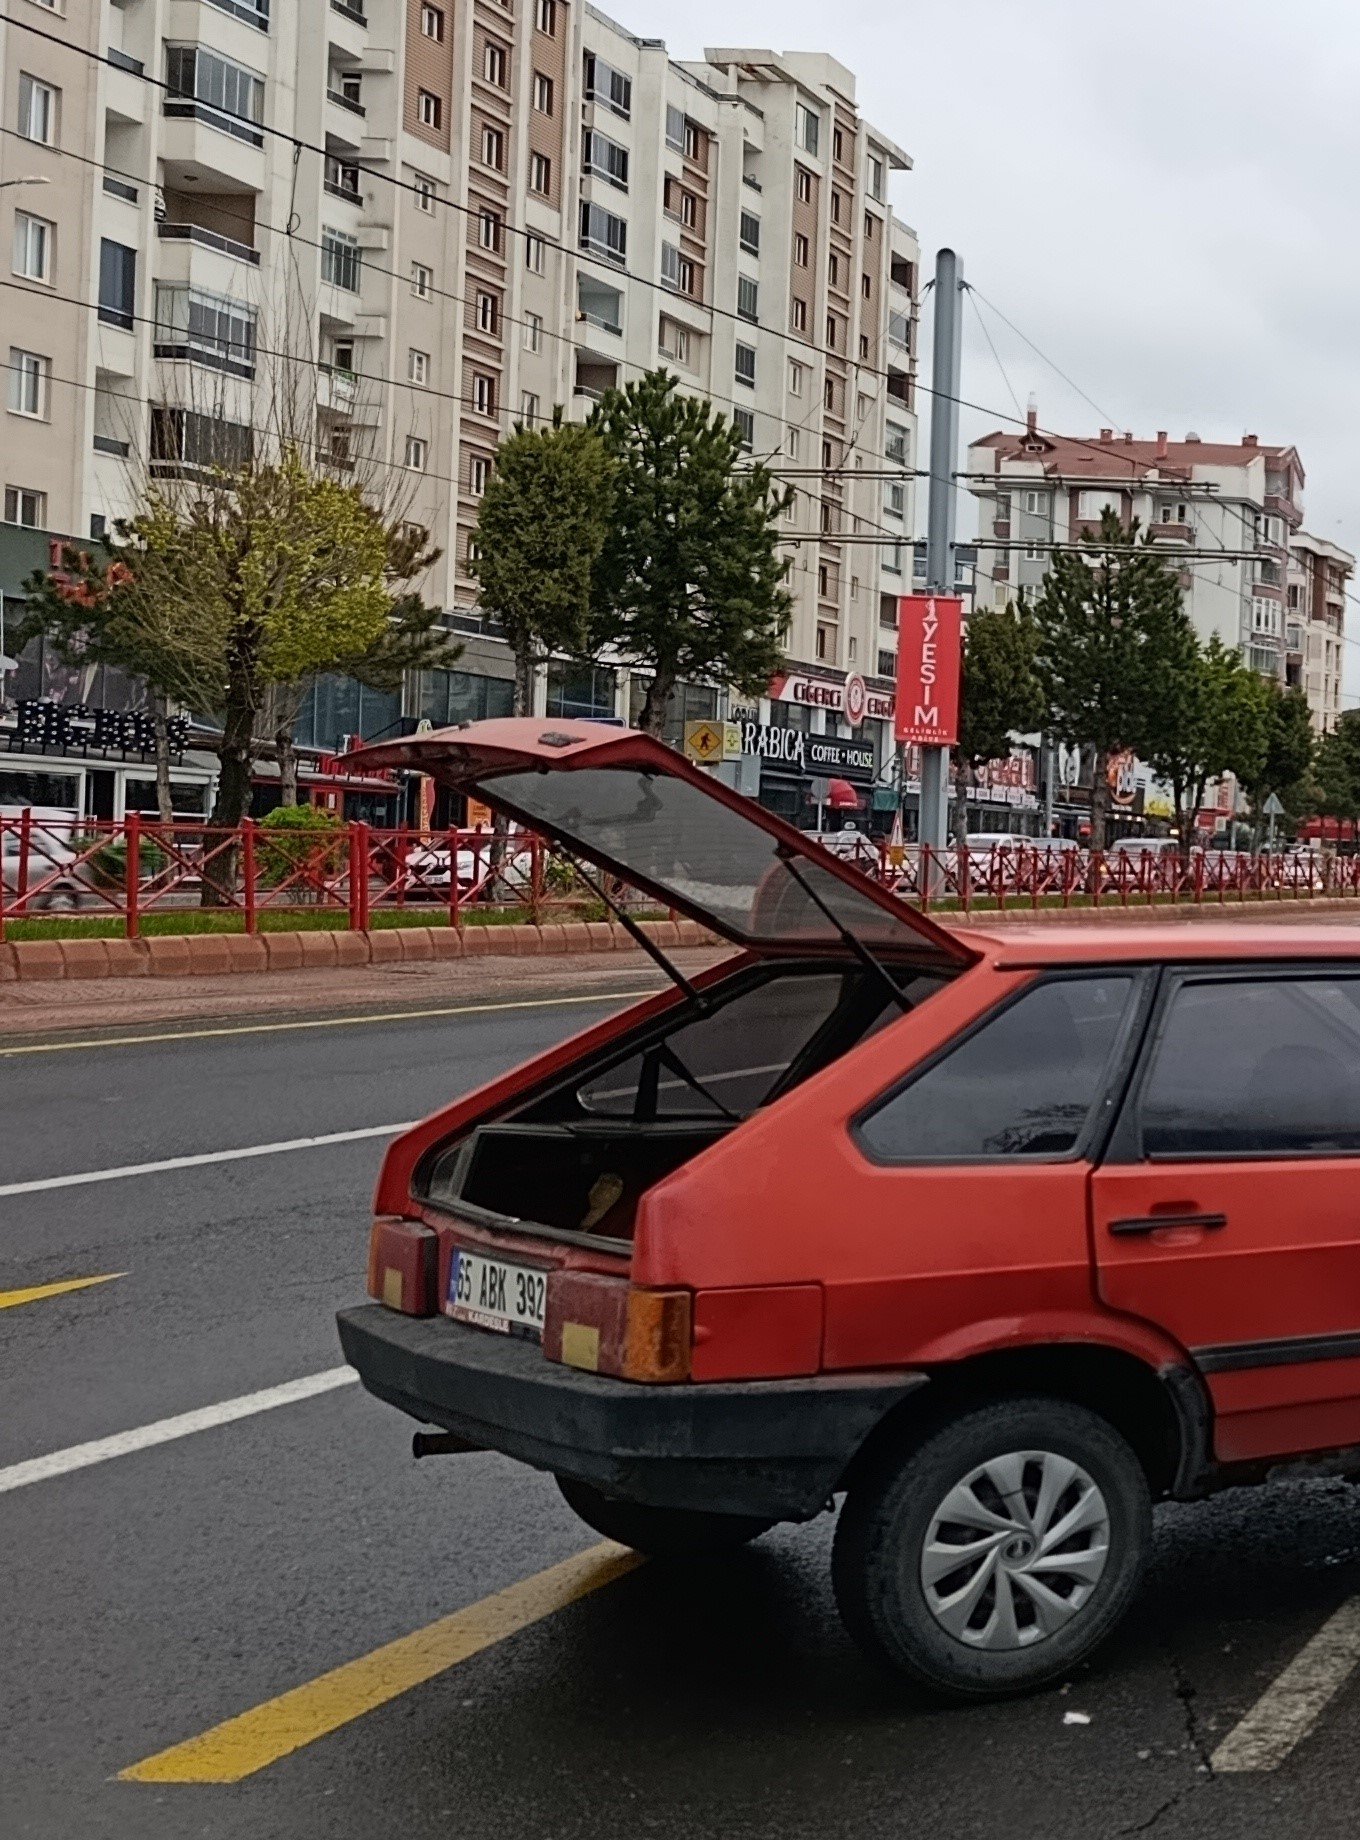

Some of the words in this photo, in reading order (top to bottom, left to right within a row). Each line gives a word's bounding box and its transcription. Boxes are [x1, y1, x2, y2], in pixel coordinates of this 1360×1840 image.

[811, 744, 840, 764] COFFEE
[846, 750, 874, 768] HOUSE
[457, 1258, 473, 1302] 65
[479, 1264, 507, 1312] ABK
[516, 1272, 544, 1320] 392
